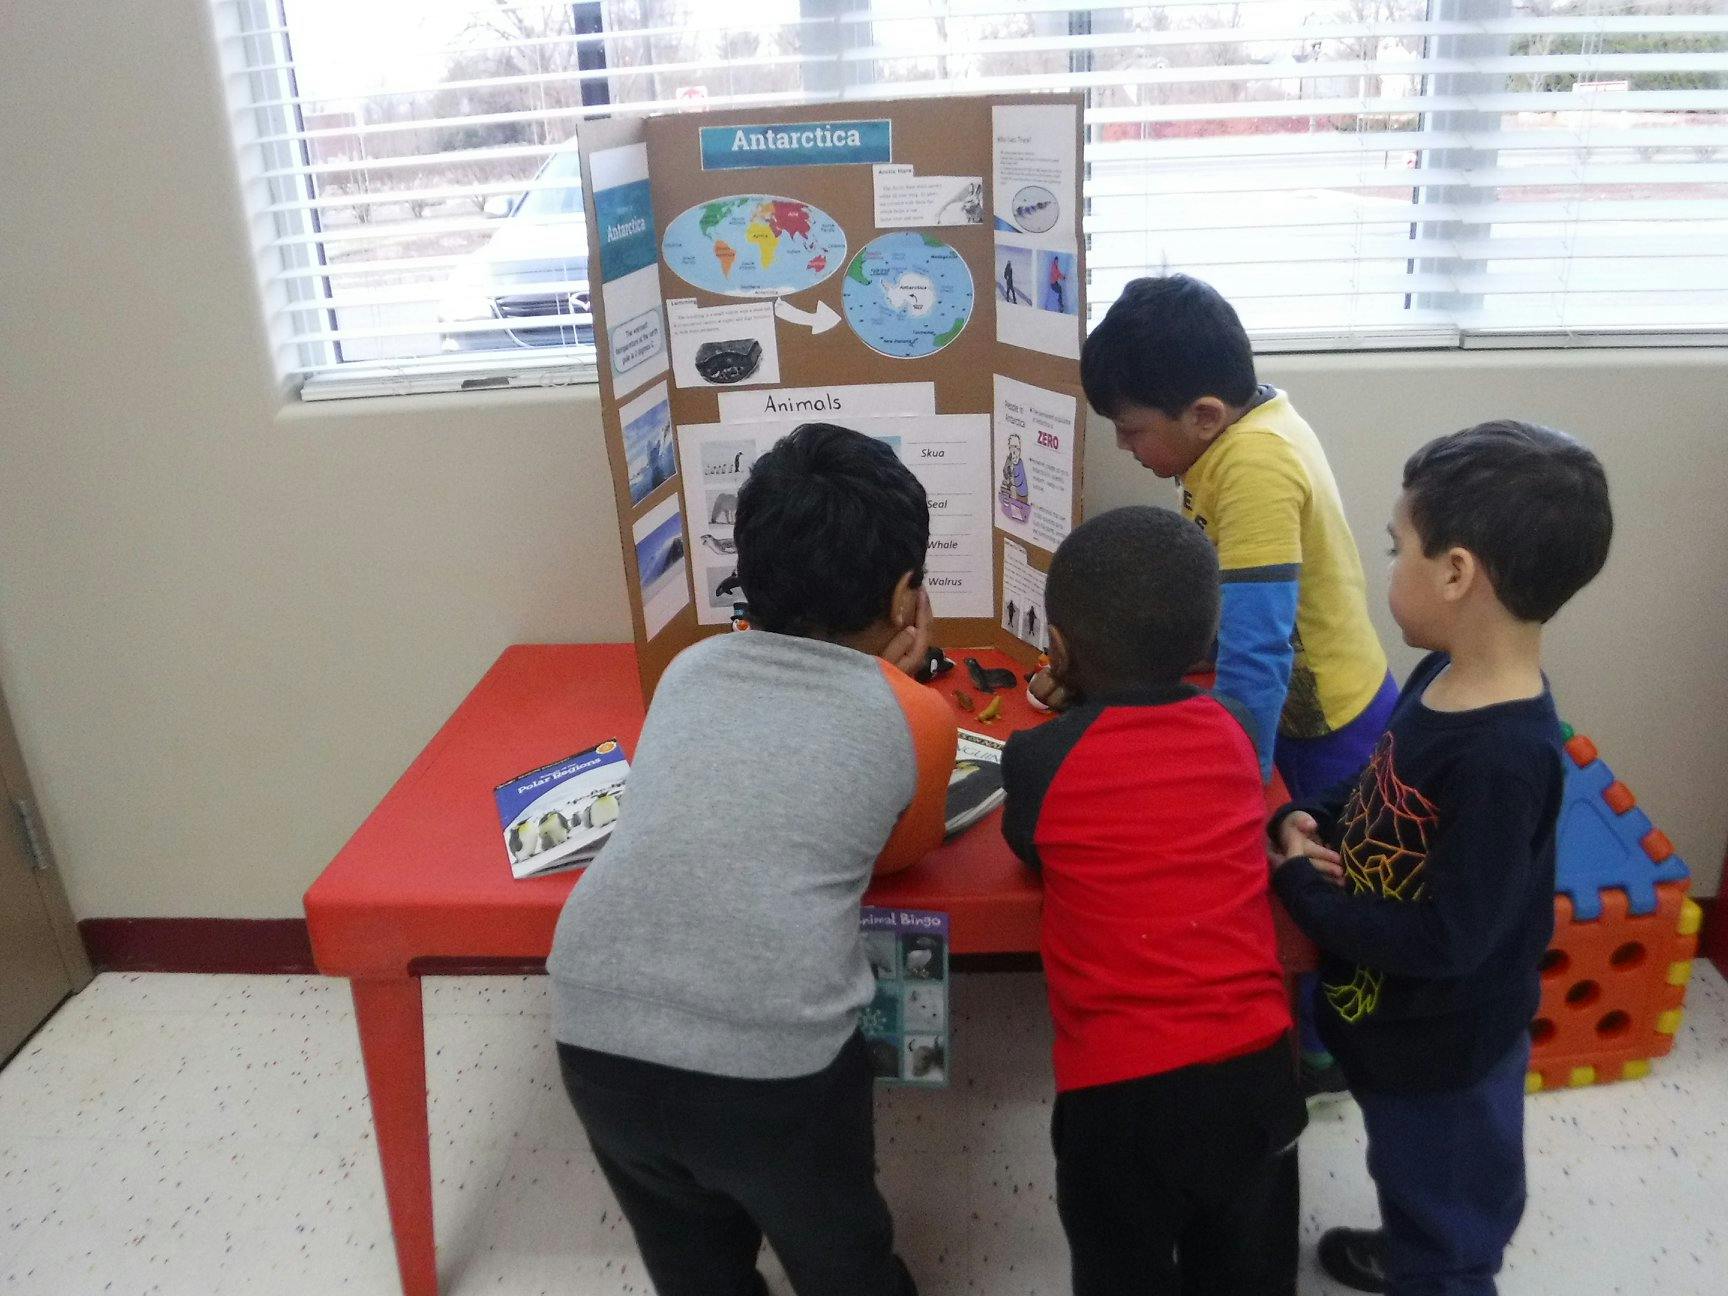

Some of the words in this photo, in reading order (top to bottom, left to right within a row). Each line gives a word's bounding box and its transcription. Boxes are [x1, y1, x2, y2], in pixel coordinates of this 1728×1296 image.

[731, 124, 861, 151] Antarctica
[607, 215, 646, 243] Antarctica
[764, 393, 842, 413] Animals
[1037, 430, 1059, 450] ZERO
[921, 448, 945, 457] Skua
[927, 499, 948, 508] Seal
[927, 540, 958, 549] Whale
[928, 577, 962, 586] Walrus
[518, 776, 551, 794] Polar
[552, 757, 602, 780] Regions
[859, 912, 897, 926] nimal
[900, 912, 942, 928] Bingo
